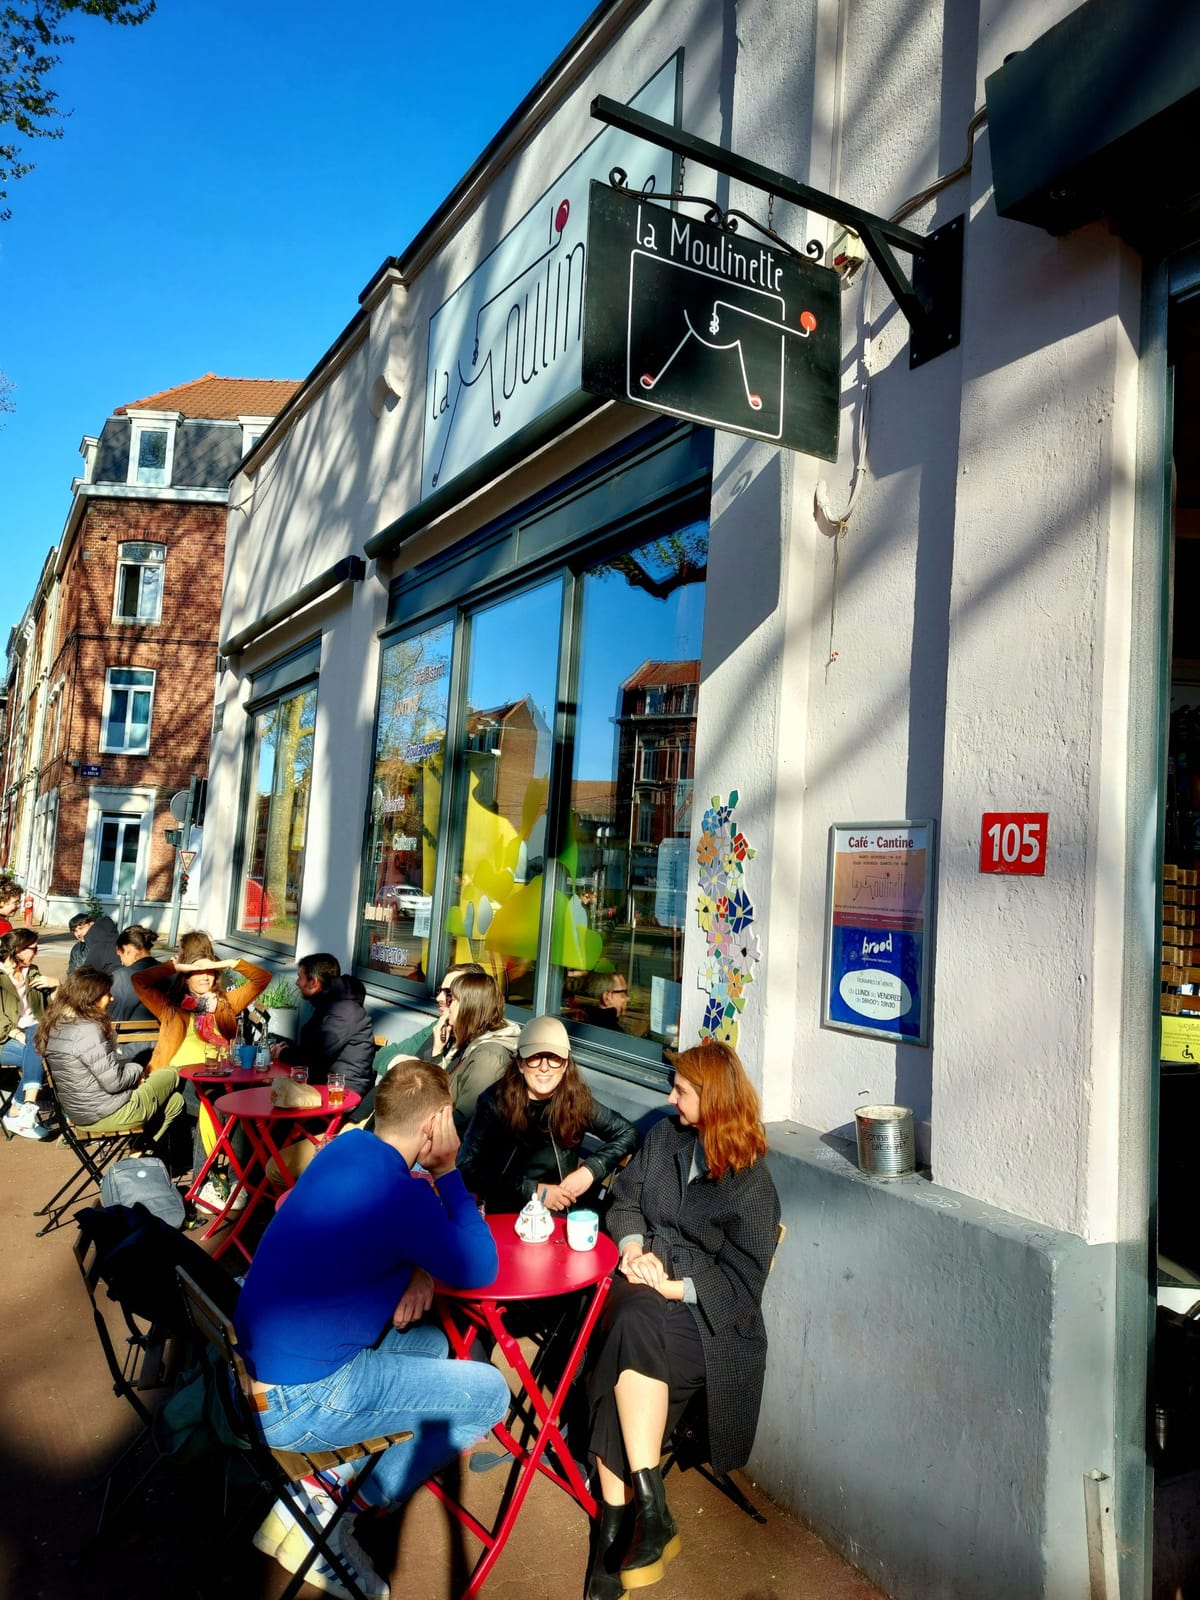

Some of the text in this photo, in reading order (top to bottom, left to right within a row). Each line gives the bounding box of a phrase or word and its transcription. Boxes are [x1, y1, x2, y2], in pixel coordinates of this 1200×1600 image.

[636, 204, 783, 292] la Moulinette
[432, 368, 450, 420] la
[848, 836, 869, 848] Café
[876, 835, 914, 848] Cantine
[988, 823, 1040, 863] 105
[862, 932, 892, 954] brood
[855, 988, 870, 997] LUNDI
